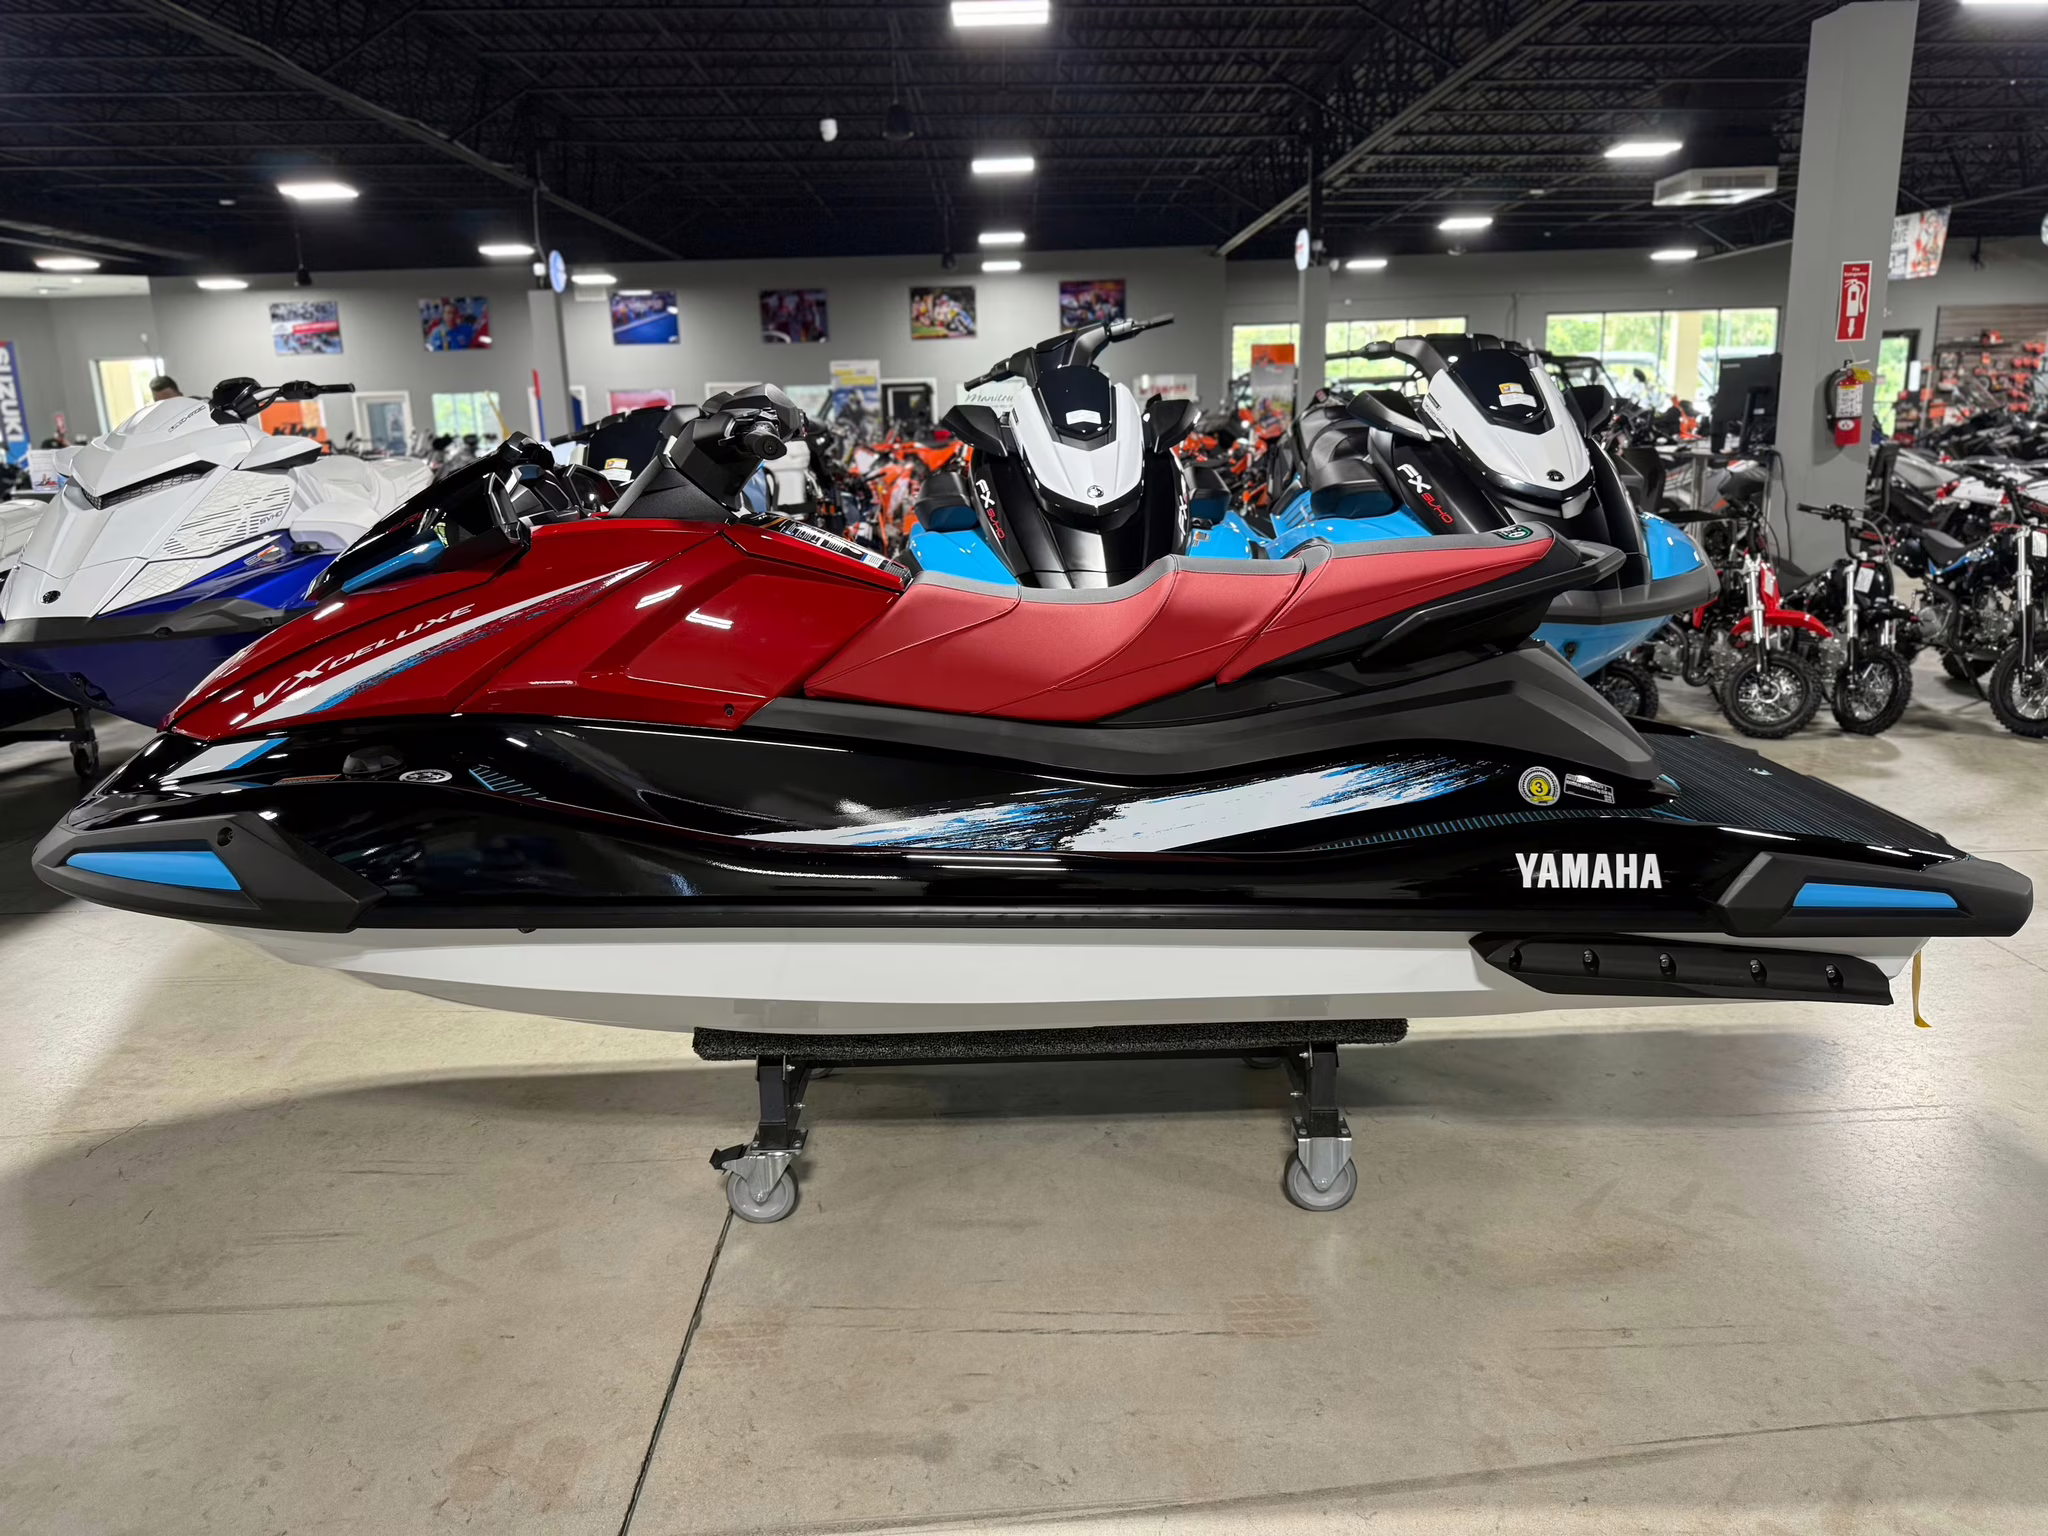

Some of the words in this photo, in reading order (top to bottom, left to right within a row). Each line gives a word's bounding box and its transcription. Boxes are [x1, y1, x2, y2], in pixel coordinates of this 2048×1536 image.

[271, 422, 319, 437] KTM
[975, 479, 995, 509] FX
[986, 507, 1006, 539] SVHO
[1397, 464, 1432, 494] FX
[1421, 492, 1454, 525] SVHO
[260, 510, 283, 525] SVHO
[253, 656, 334, 709] VX
[328, 603, 476, 671] DELUXE
[1534, 781, 1544, 793] 3
[1515, 853, 1663, 889] YAMAHA
